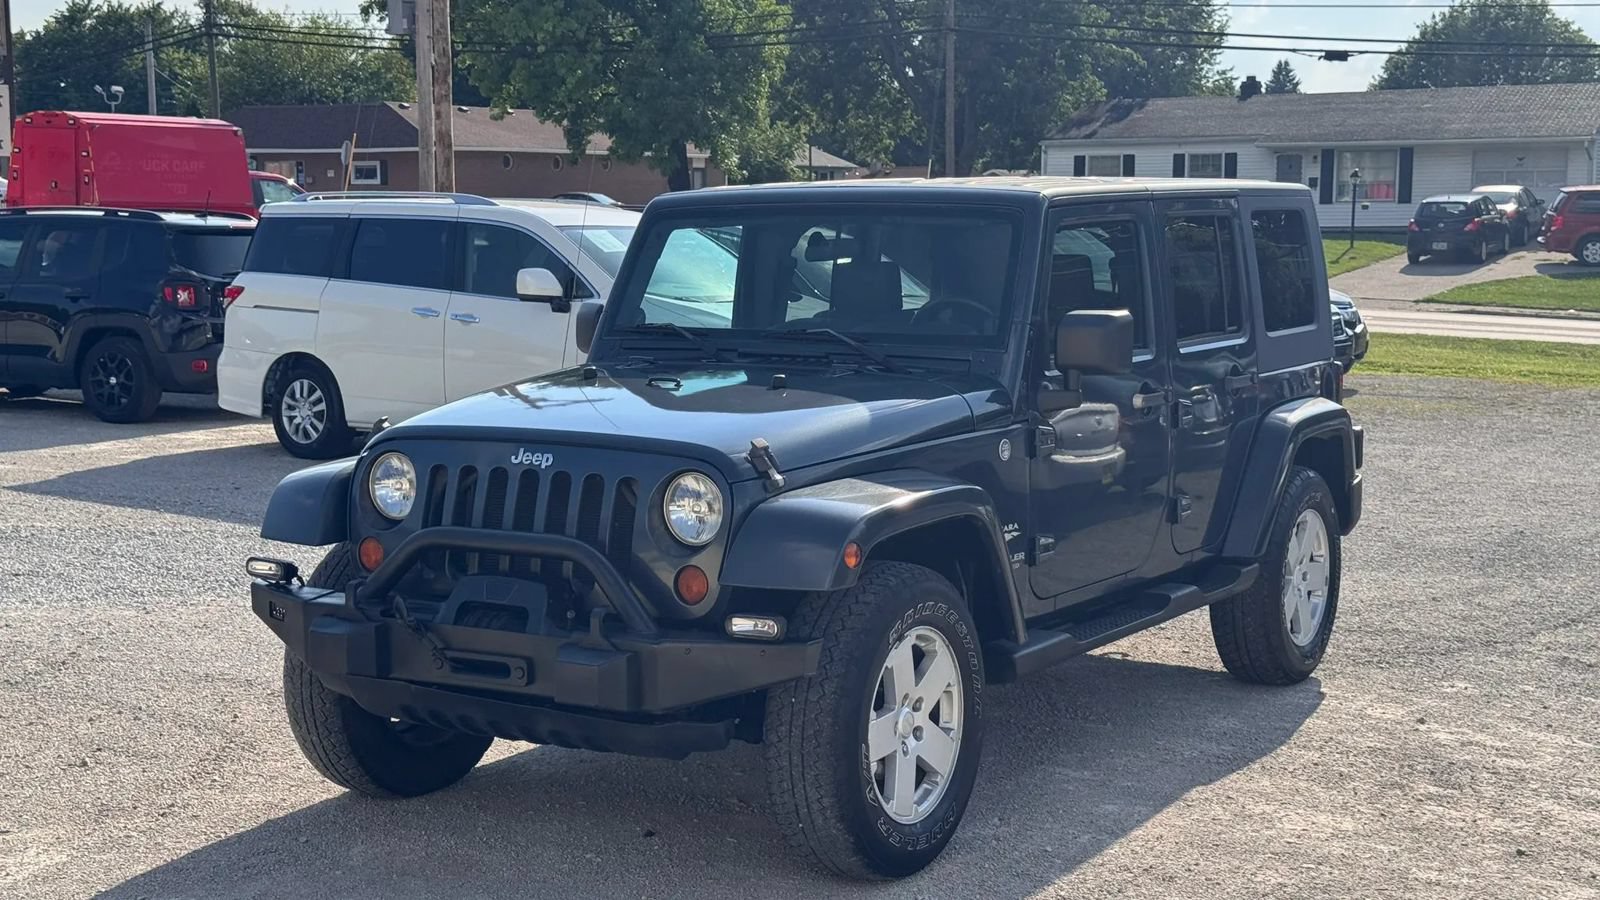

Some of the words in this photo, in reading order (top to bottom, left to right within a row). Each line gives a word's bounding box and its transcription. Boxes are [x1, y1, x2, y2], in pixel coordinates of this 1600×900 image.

[511, 447, 554, 469] Jeep
[1001, 522, 1020, 532] ARA
[877, 801, 958, 851] DUELER
